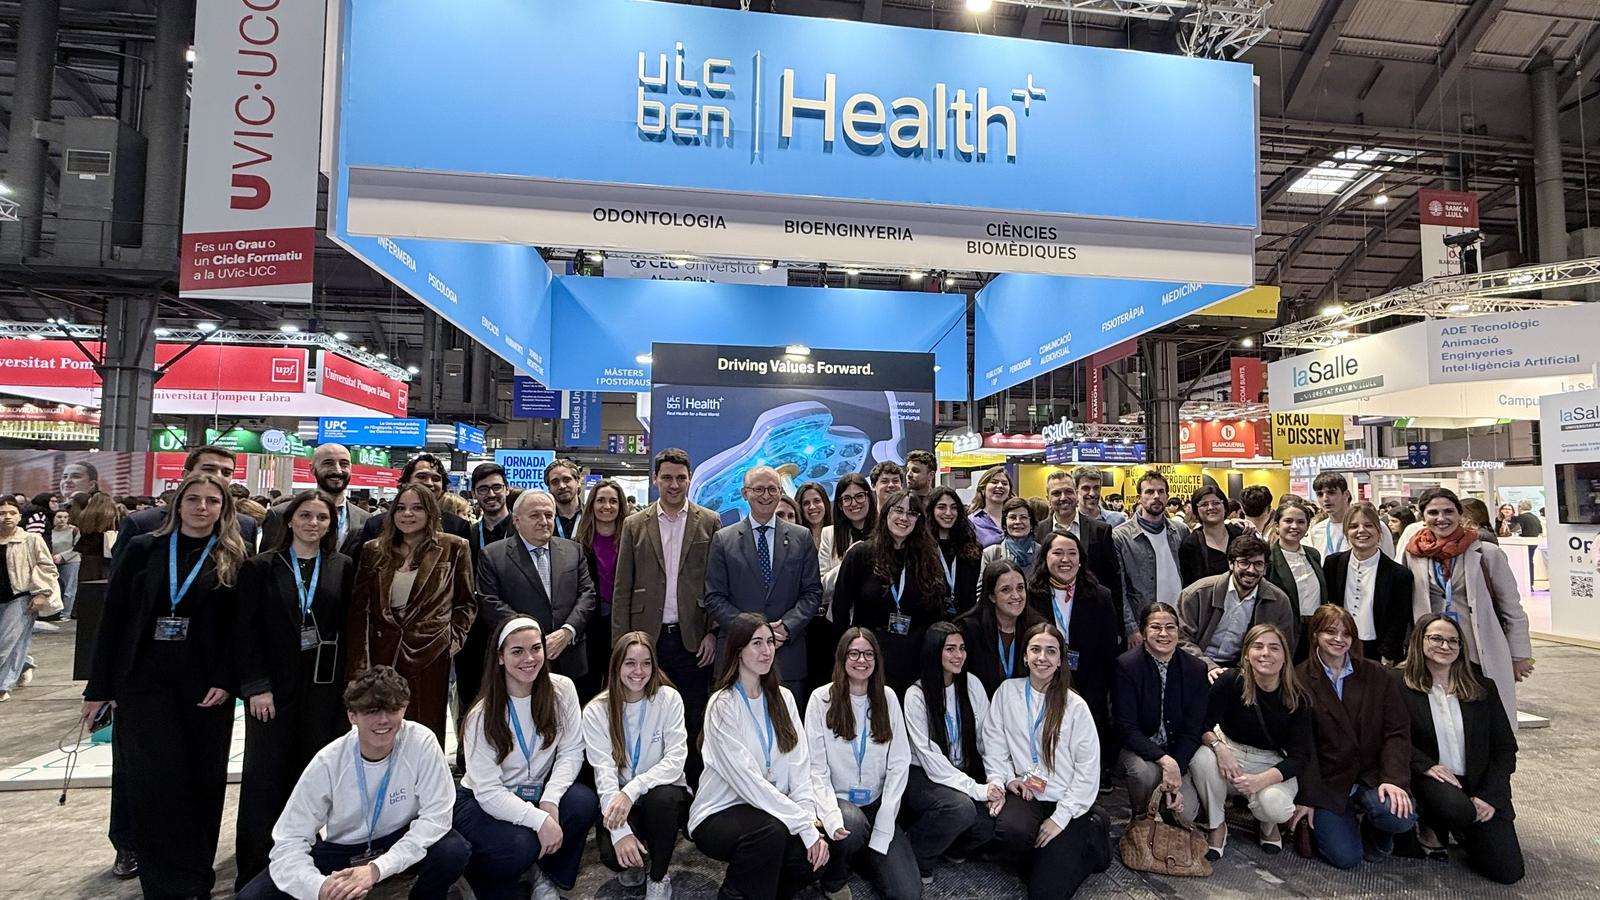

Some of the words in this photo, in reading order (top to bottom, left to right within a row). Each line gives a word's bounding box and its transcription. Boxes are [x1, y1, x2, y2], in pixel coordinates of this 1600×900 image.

[593, 207, 727, 229] ODONTOLOGIA
[784, 219, 913, 241] BIOENGINYERIA
[986, 222, 1058, 241] CIÈNCIES
[194, 242, 215, 252] Fes
[218, 242, 233, 251] un
[235, 240, 266, 250] Grau
[267, 240, 276, 248] o
[966, 239, 1077, 262] BIOMÈDIQUES
[194, 257, 210, 267] un
[212, 254, 245, 265] Cicle
[246, 250, 303, 263] Formatiu
[204, 269, 215, 280] la
[217, 265, 277, 279] UVic-UCC
[427, 272, 458, 305] PSICOLOGIA
[1441, 325, 1467, 336] ADE
[1471, 319, 1540, 334] Tecnològic
[1441, 336, 1499, 349] Animació
[0, 355, 56, 369] versitat
[1441, 347, 1513, 362] Enginyeries
[1524, 354, 1581, 367] Artificial
[718, 358, 768, 375] Driving
[770, 360, 815, 374] Values
[817, 361, 875, 376] Forward.
[600, 377, 651, 387] POSTGRAUS
[153, 391, 207, 401] niversitat
[259, 393, 291, 403] Fabra
[1498, 394, 1541, 408] Campu
[324, 420, 348, 430] UPC
[571, 404, 580, 440] Estudis
[1042, 416, 1074, 441] esade
[619, 435, 625, 444] 3
[1277, 427, 1286, 437] EN
[1287, 428, 1340, 446] DISSENY
[503, 455, 546, 468] JORNADA
[1291, 457, 1309, 470] ART
[513, 468, 544, 480] PORTE
